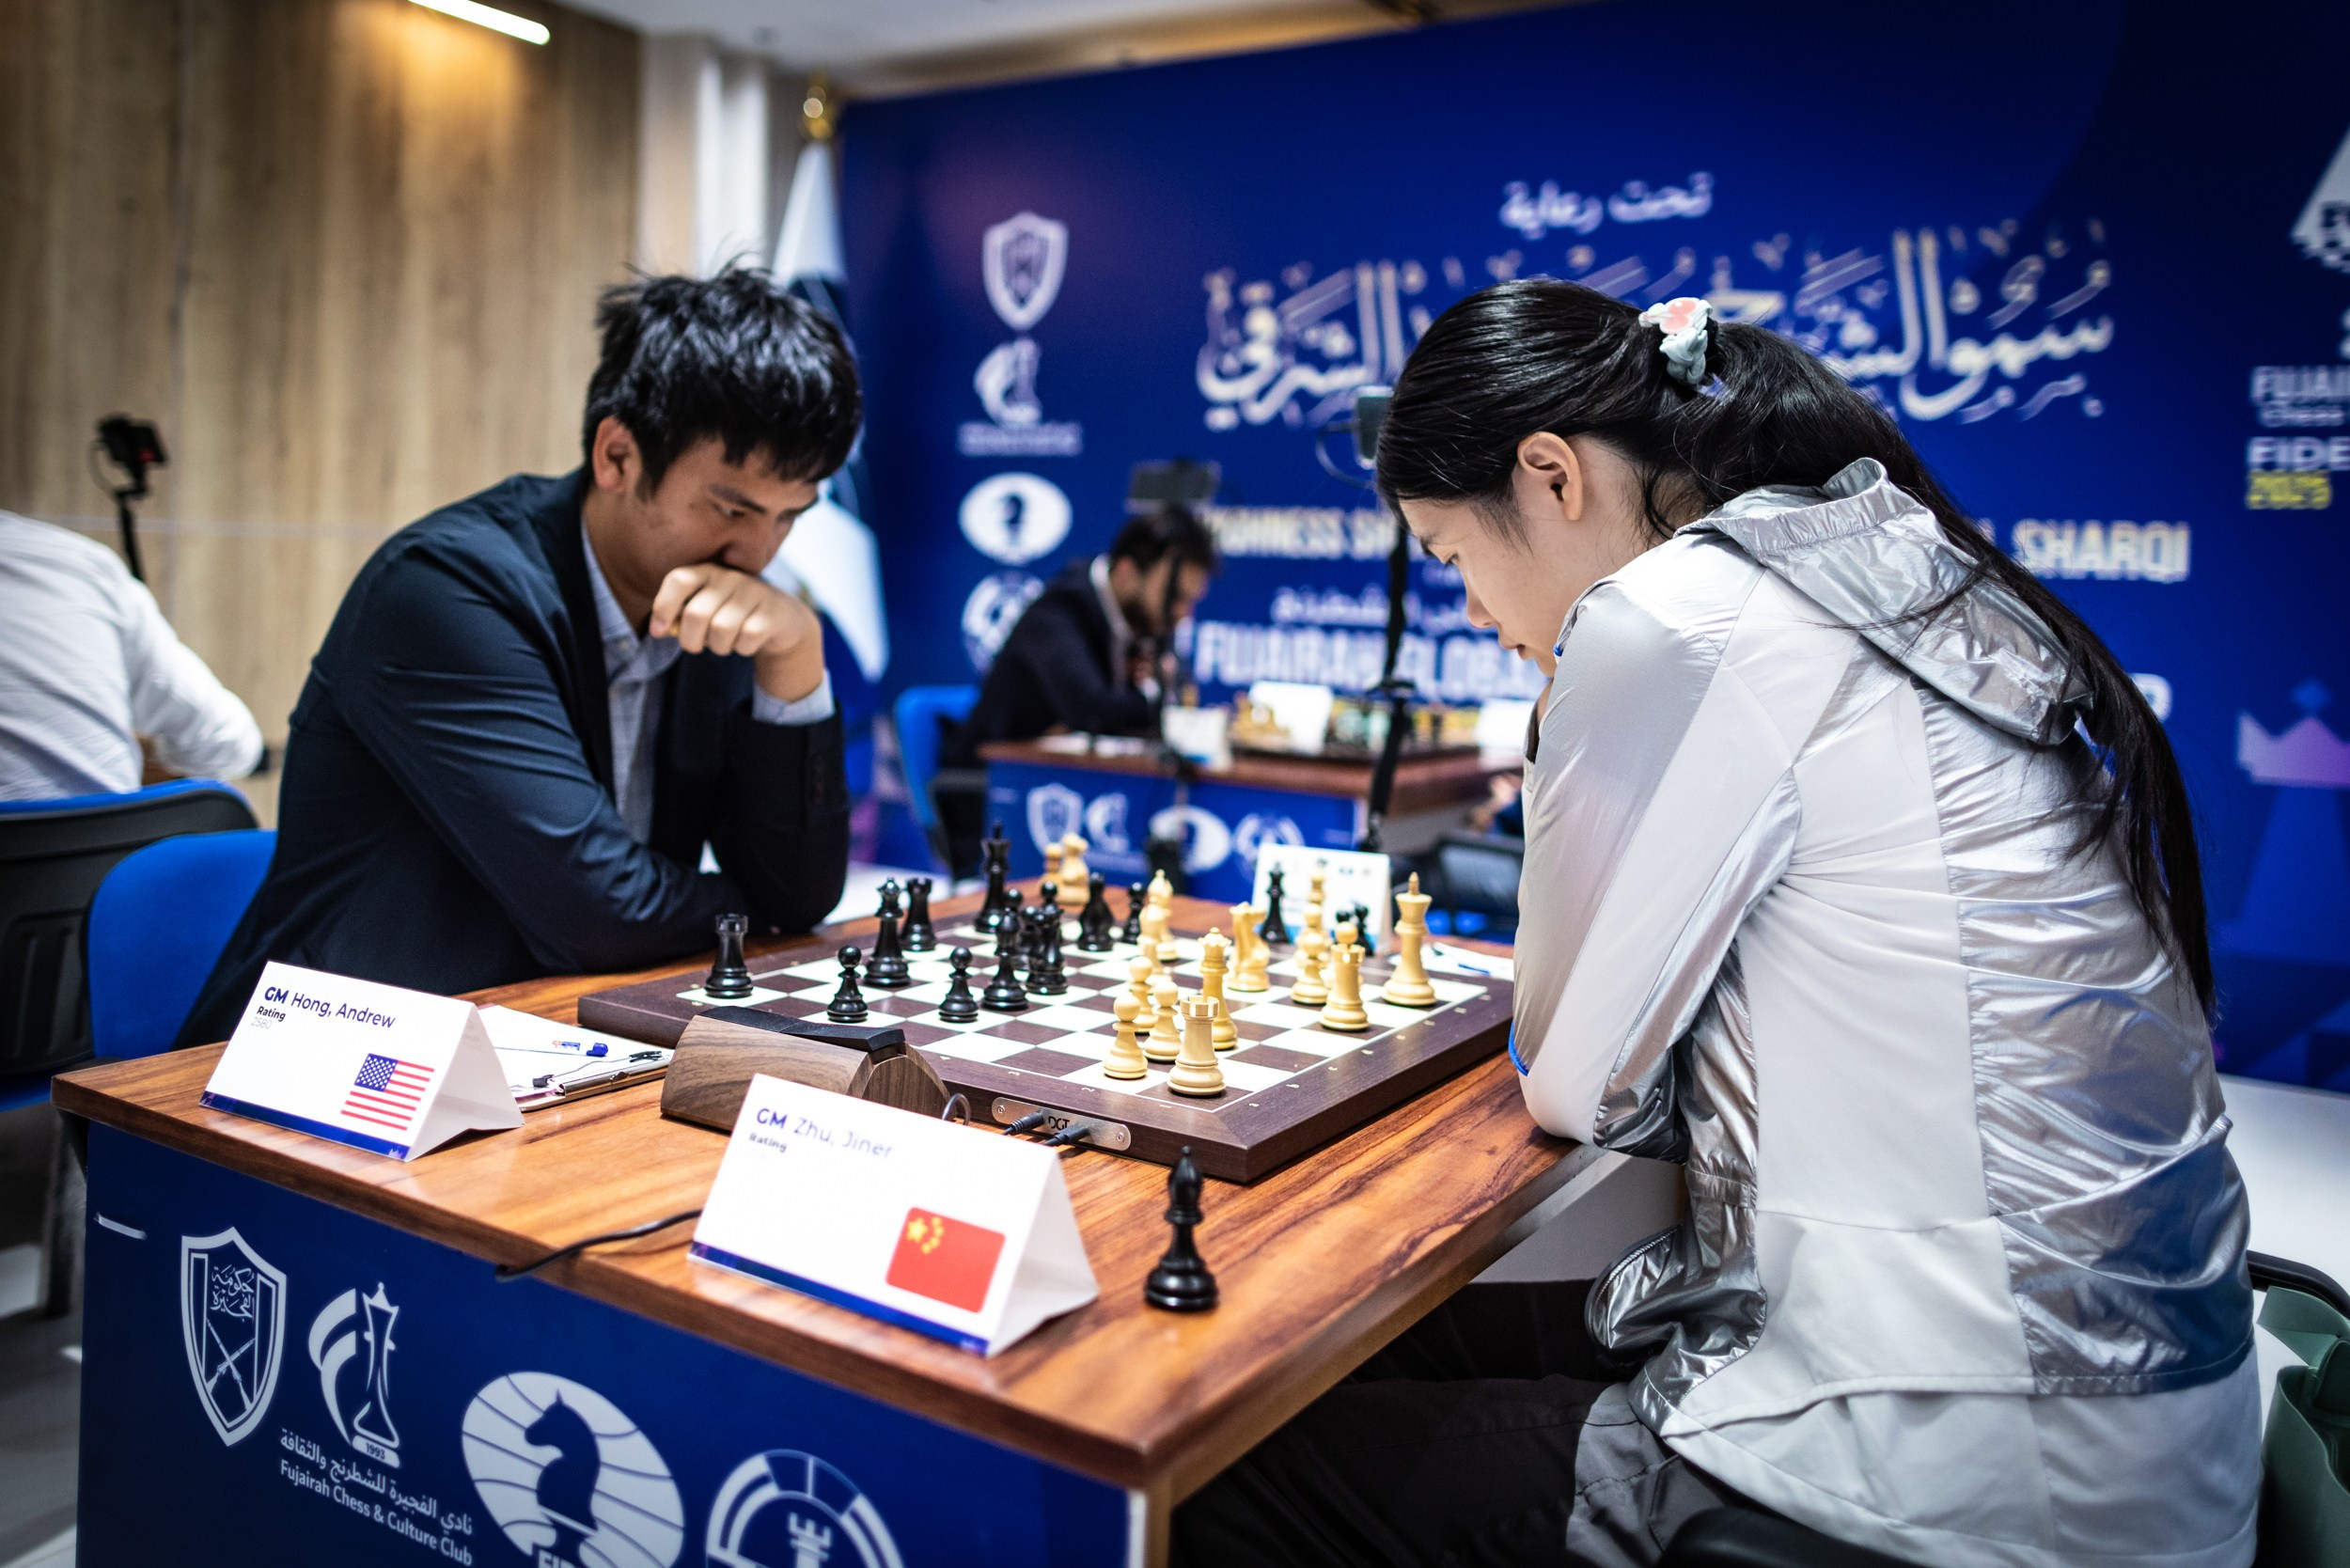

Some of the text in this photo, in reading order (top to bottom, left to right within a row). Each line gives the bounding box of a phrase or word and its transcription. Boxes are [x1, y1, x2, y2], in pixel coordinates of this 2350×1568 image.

[2248, 436, 2350, 470] FIDE
[2012, 519, 2190, 583] SHARQI
[257, 1006, 286, 1023] Rating
[264, 986, 396, 1028] GM Hong, Andrew
[250, 1016, 273, 1029] 2580
[1048, 1116, 1070, 1131] DGT
[749, 1132, 788, 1153] Rating
[842, 1131, 892, 1158] Jiner
[280, 1427, 473, 1536] نادي الفجيرة للشطرنج والثقافة
[280, 1459, 473, 1568] Fujairah Chess & Culture Club
